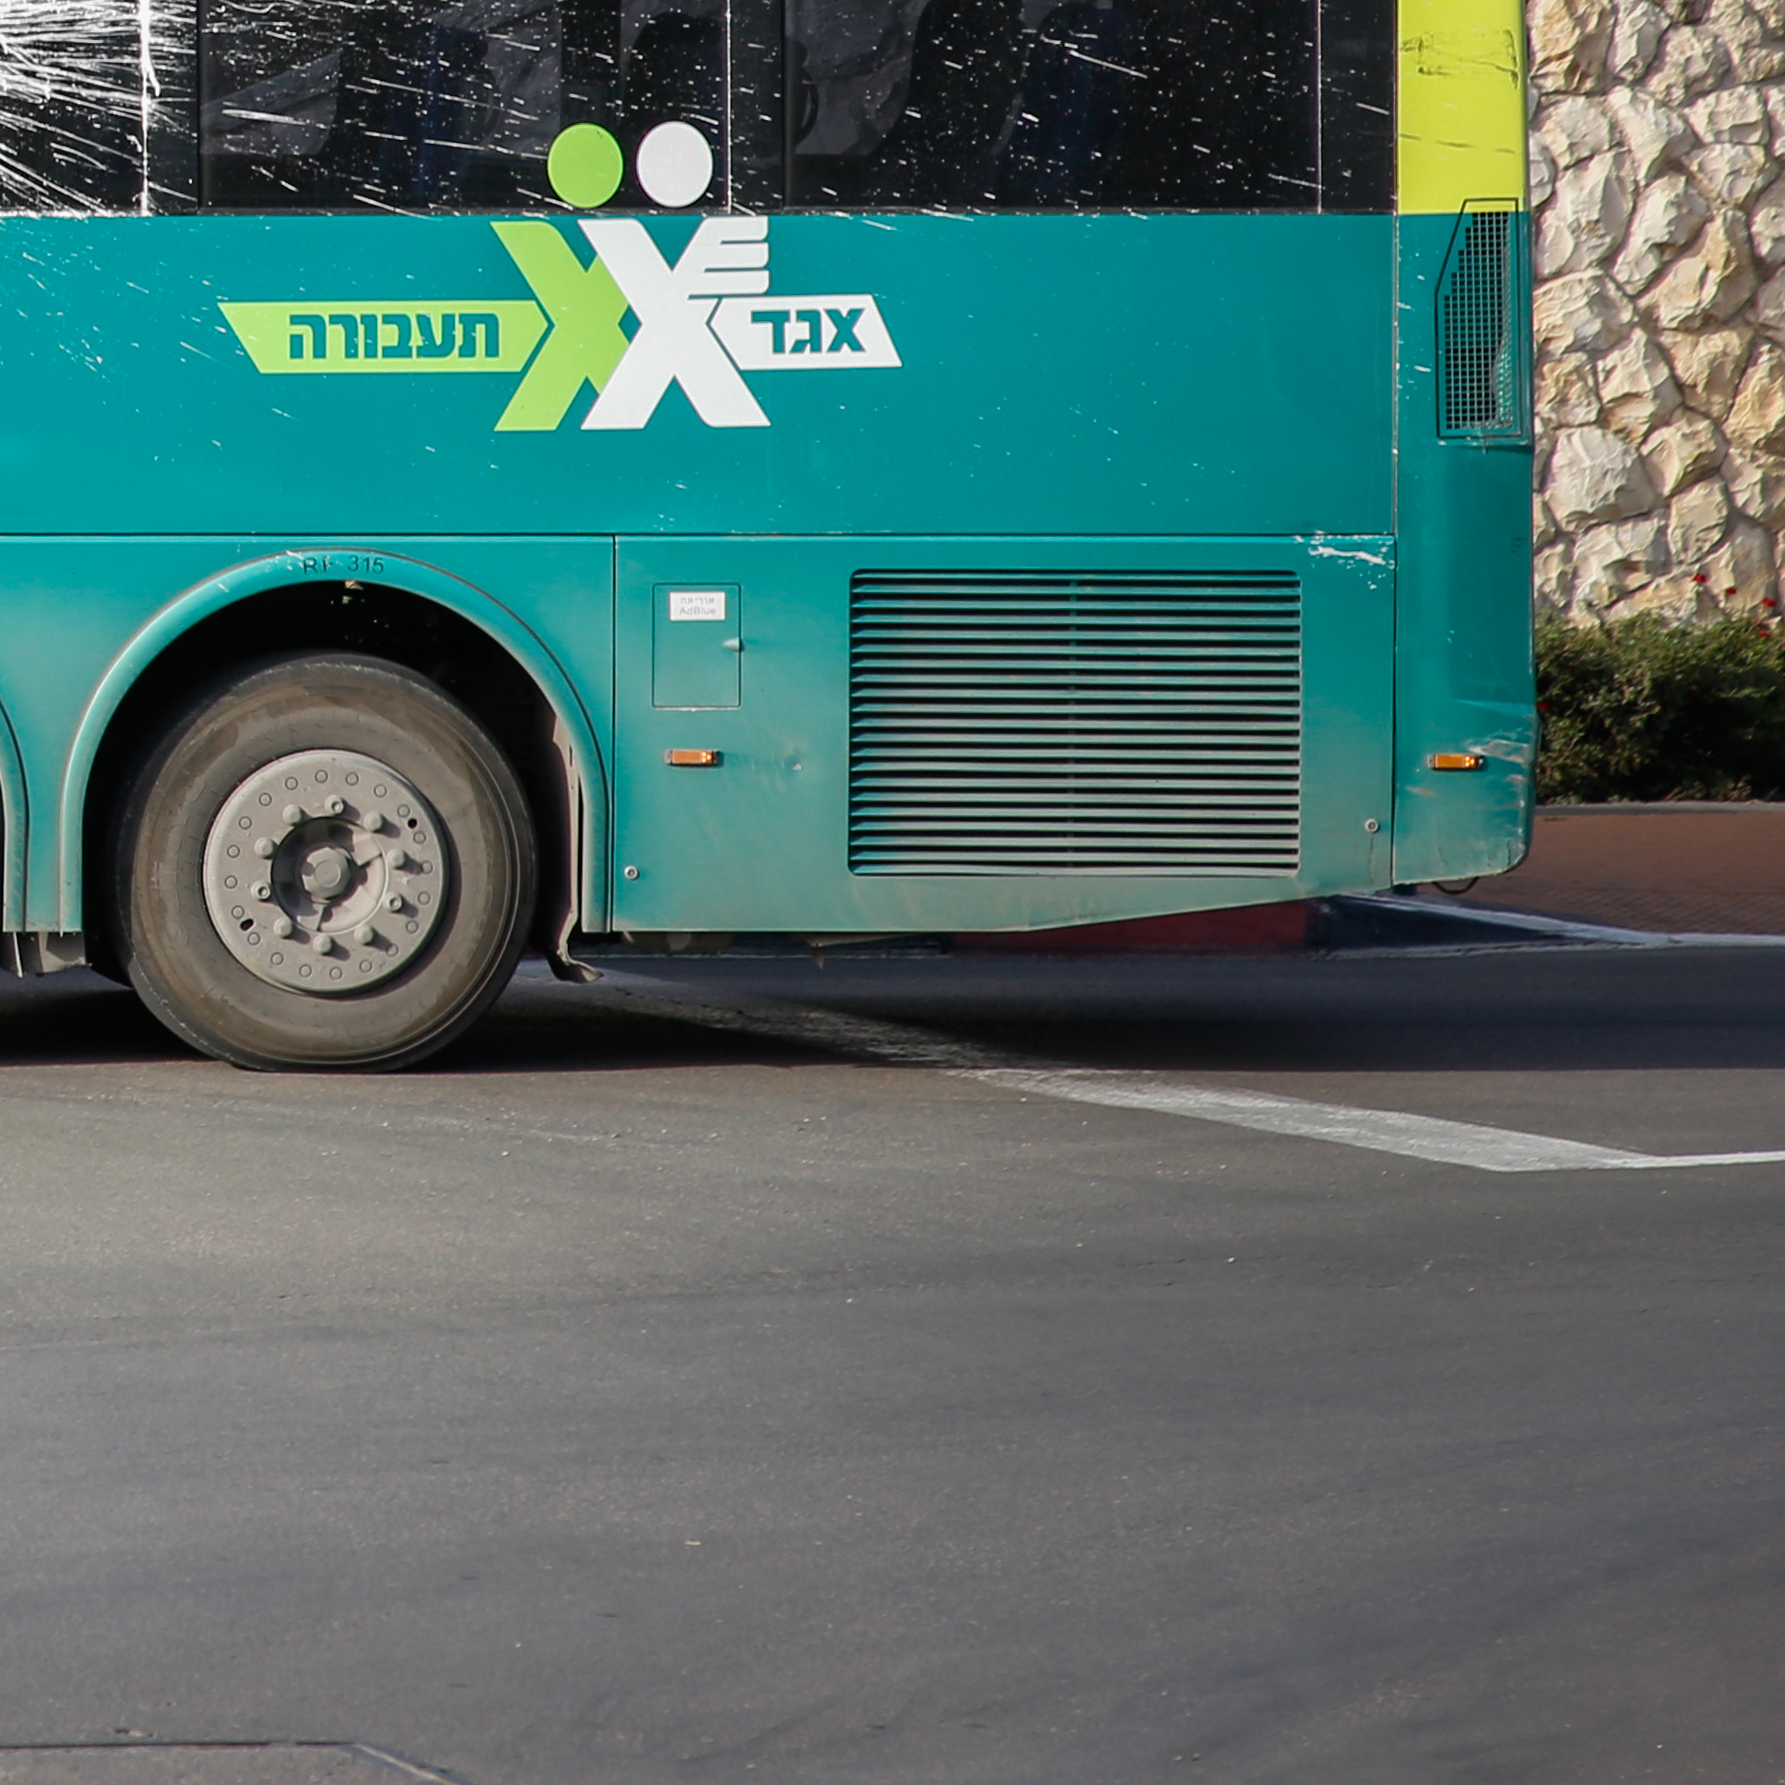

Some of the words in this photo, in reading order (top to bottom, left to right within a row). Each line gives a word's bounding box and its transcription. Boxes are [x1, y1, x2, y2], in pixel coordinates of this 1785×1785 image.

[288, 312, 501, 360] תעבורה
[749, 307, 868, 355] אגד
[347, 555, 385, 574] 315
[679, 606, 717, 616] AdBlue
